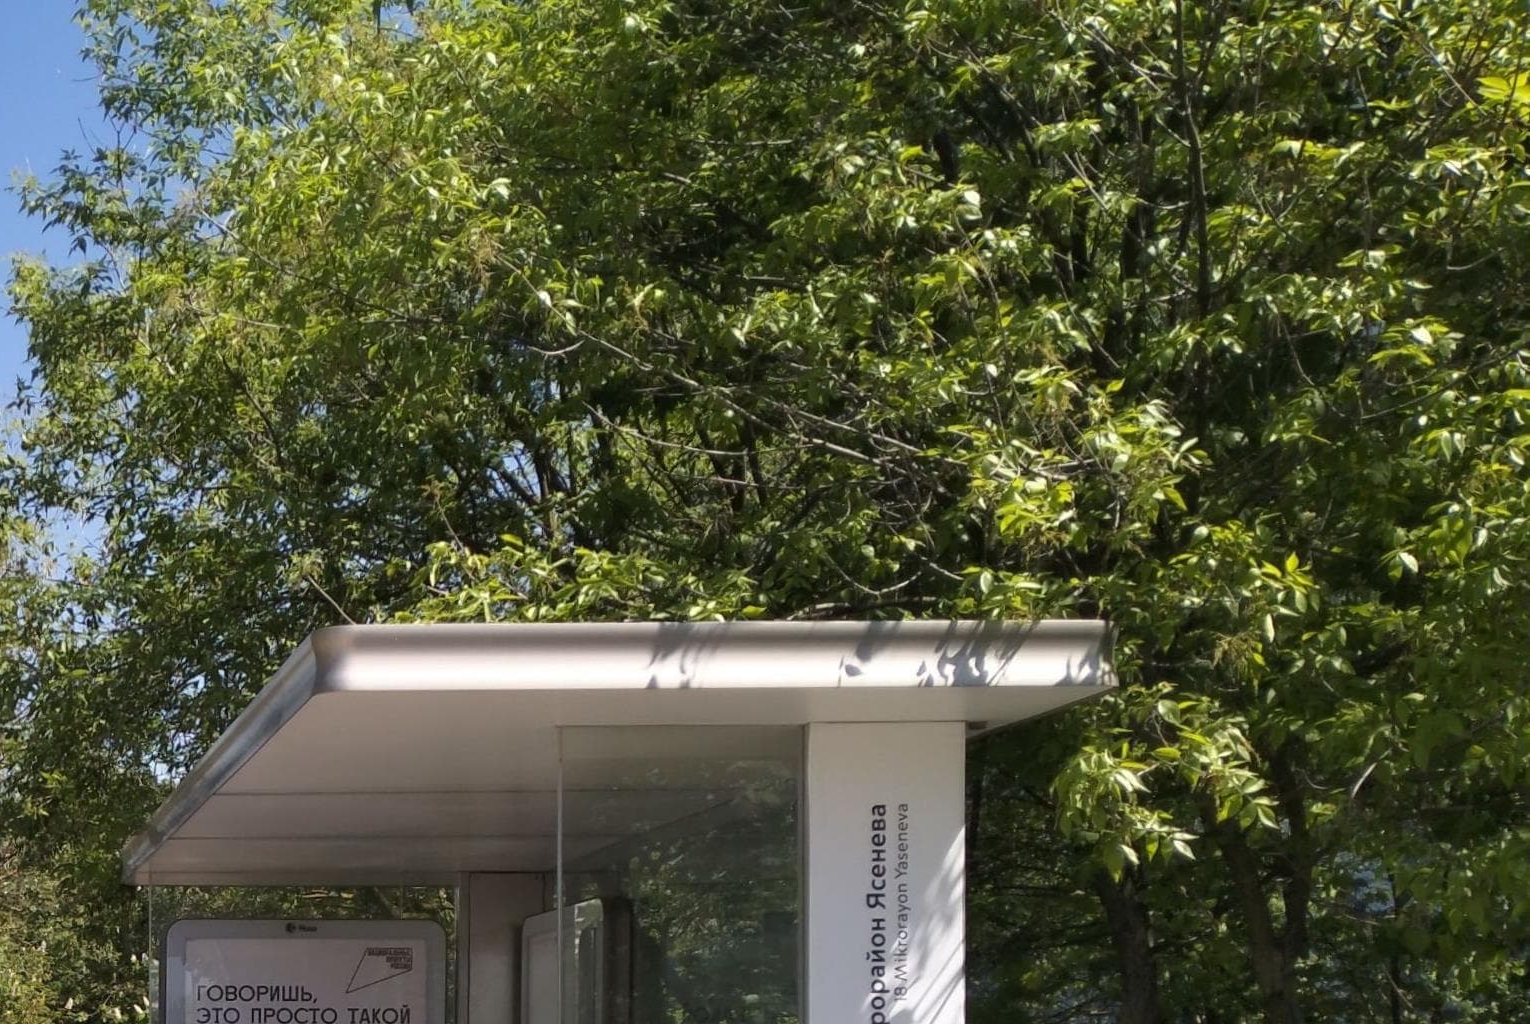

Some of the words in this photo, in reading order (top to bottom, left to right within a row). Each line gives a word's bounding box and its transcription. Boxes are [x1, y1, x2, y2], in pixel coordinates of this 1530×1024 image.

[866, 803, 887, 909] Ясенева
[894, 803, 909, 881] Yaseneva
[894, 883, 912, 983] Mikrorayon
[196, 1007, 241, 1024] ЭТО
[251, 1007, 338, 1024] ПРОСТО
[347, 1004, 411, 1024] ТАКОЙ
[197, 984, 318, 1003] ГОВОРИШЬ,
[894, 986, 908, 1002] 18
